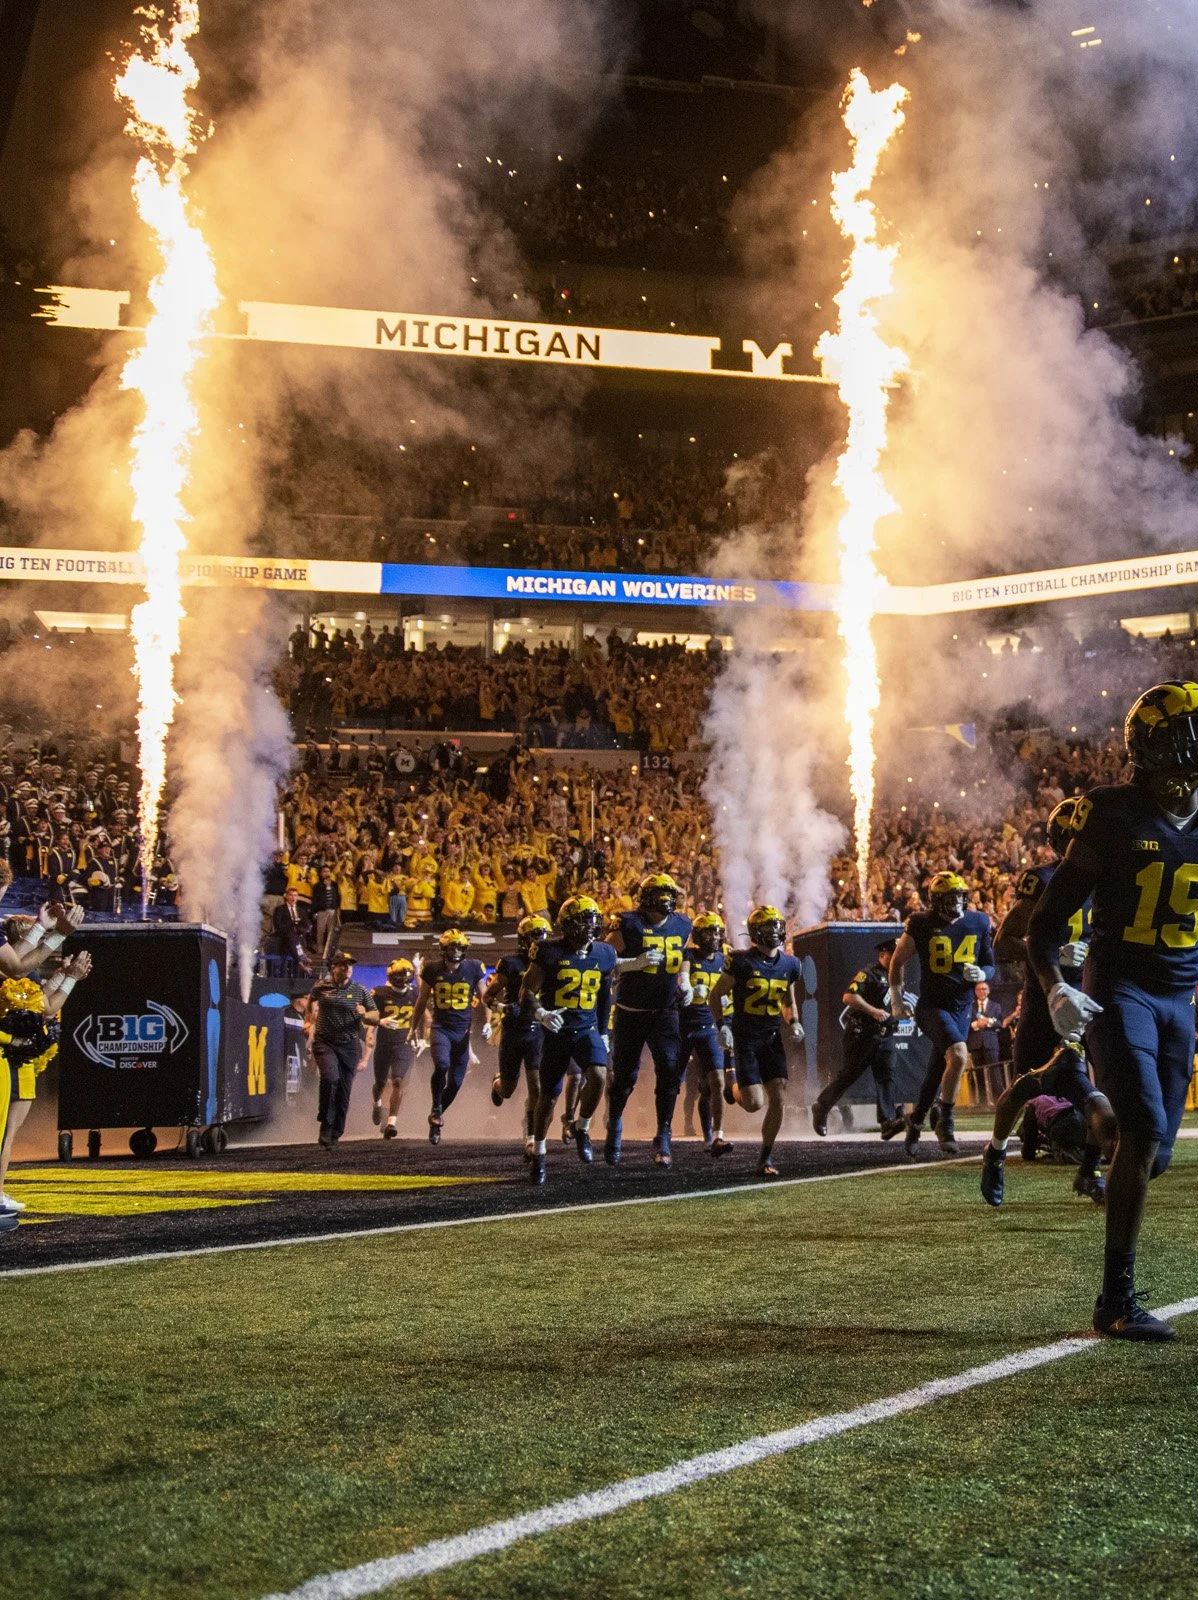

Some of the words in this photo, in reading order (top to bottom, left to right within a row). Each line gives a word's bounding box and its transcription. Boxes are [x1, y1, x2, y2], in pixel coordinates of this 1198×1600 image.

[375, 318, 600, 361] MICHIGAN
[0, 557, 15, 569] IG
[20, 558, 51, 571] TEN
[263, 568, 308, 581] GAME
[952, 589, 972, 602] BIG
[977, 586, 1000, 599] TEN
[1004, 578, 1068, 596] FOOTBALL
[1071, 565, 1172, 588] CHAMPIONSHIP
[506, 575, 616, 596] MICHIGAN
[622, 581, 757, 602] WOLVERINES
[643, 754, 671, 769] 132
[642, 936, 682, 974] 76
[929, 934, 977, 974] 84
[554, 968, 601, 1010] 28
[743, 977, 789, 1016] 25
[384, 1005, 414, 1029] 22
[98, 1042, 164, 1052] CHAMPIONSHIP
[120, 1061, 157, 1069] DISCOVER
